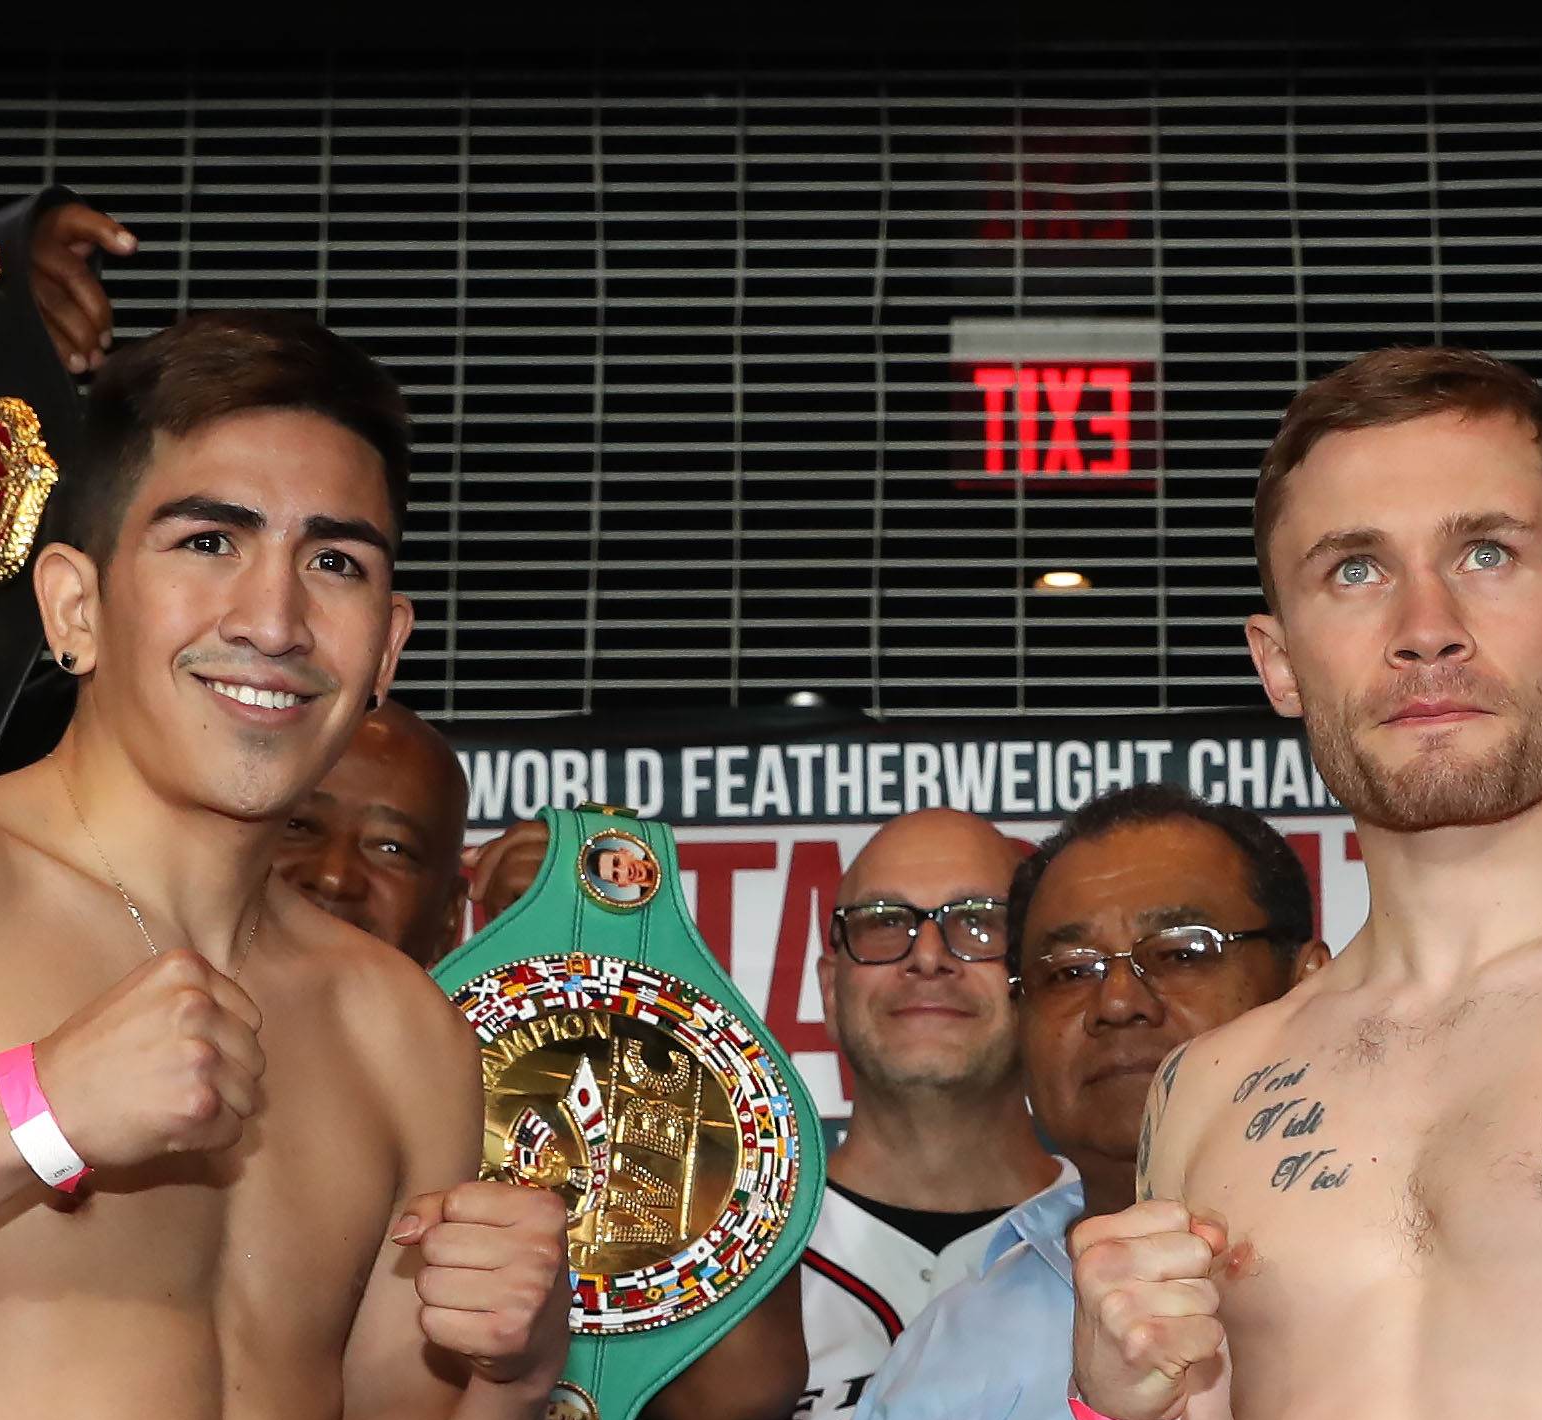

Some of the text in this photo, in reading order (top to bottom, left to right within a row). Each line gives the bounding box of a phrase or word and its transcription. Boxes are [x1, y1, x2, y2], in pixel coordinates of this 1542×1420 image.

[462, 747, 665, 819] WORLD
[681, 738, 1171, 817] FEATHERWEIGHT
[1244, 1097, 1326, 1142] Vidi
[1270, 1148, 1353, 1193] Vici
